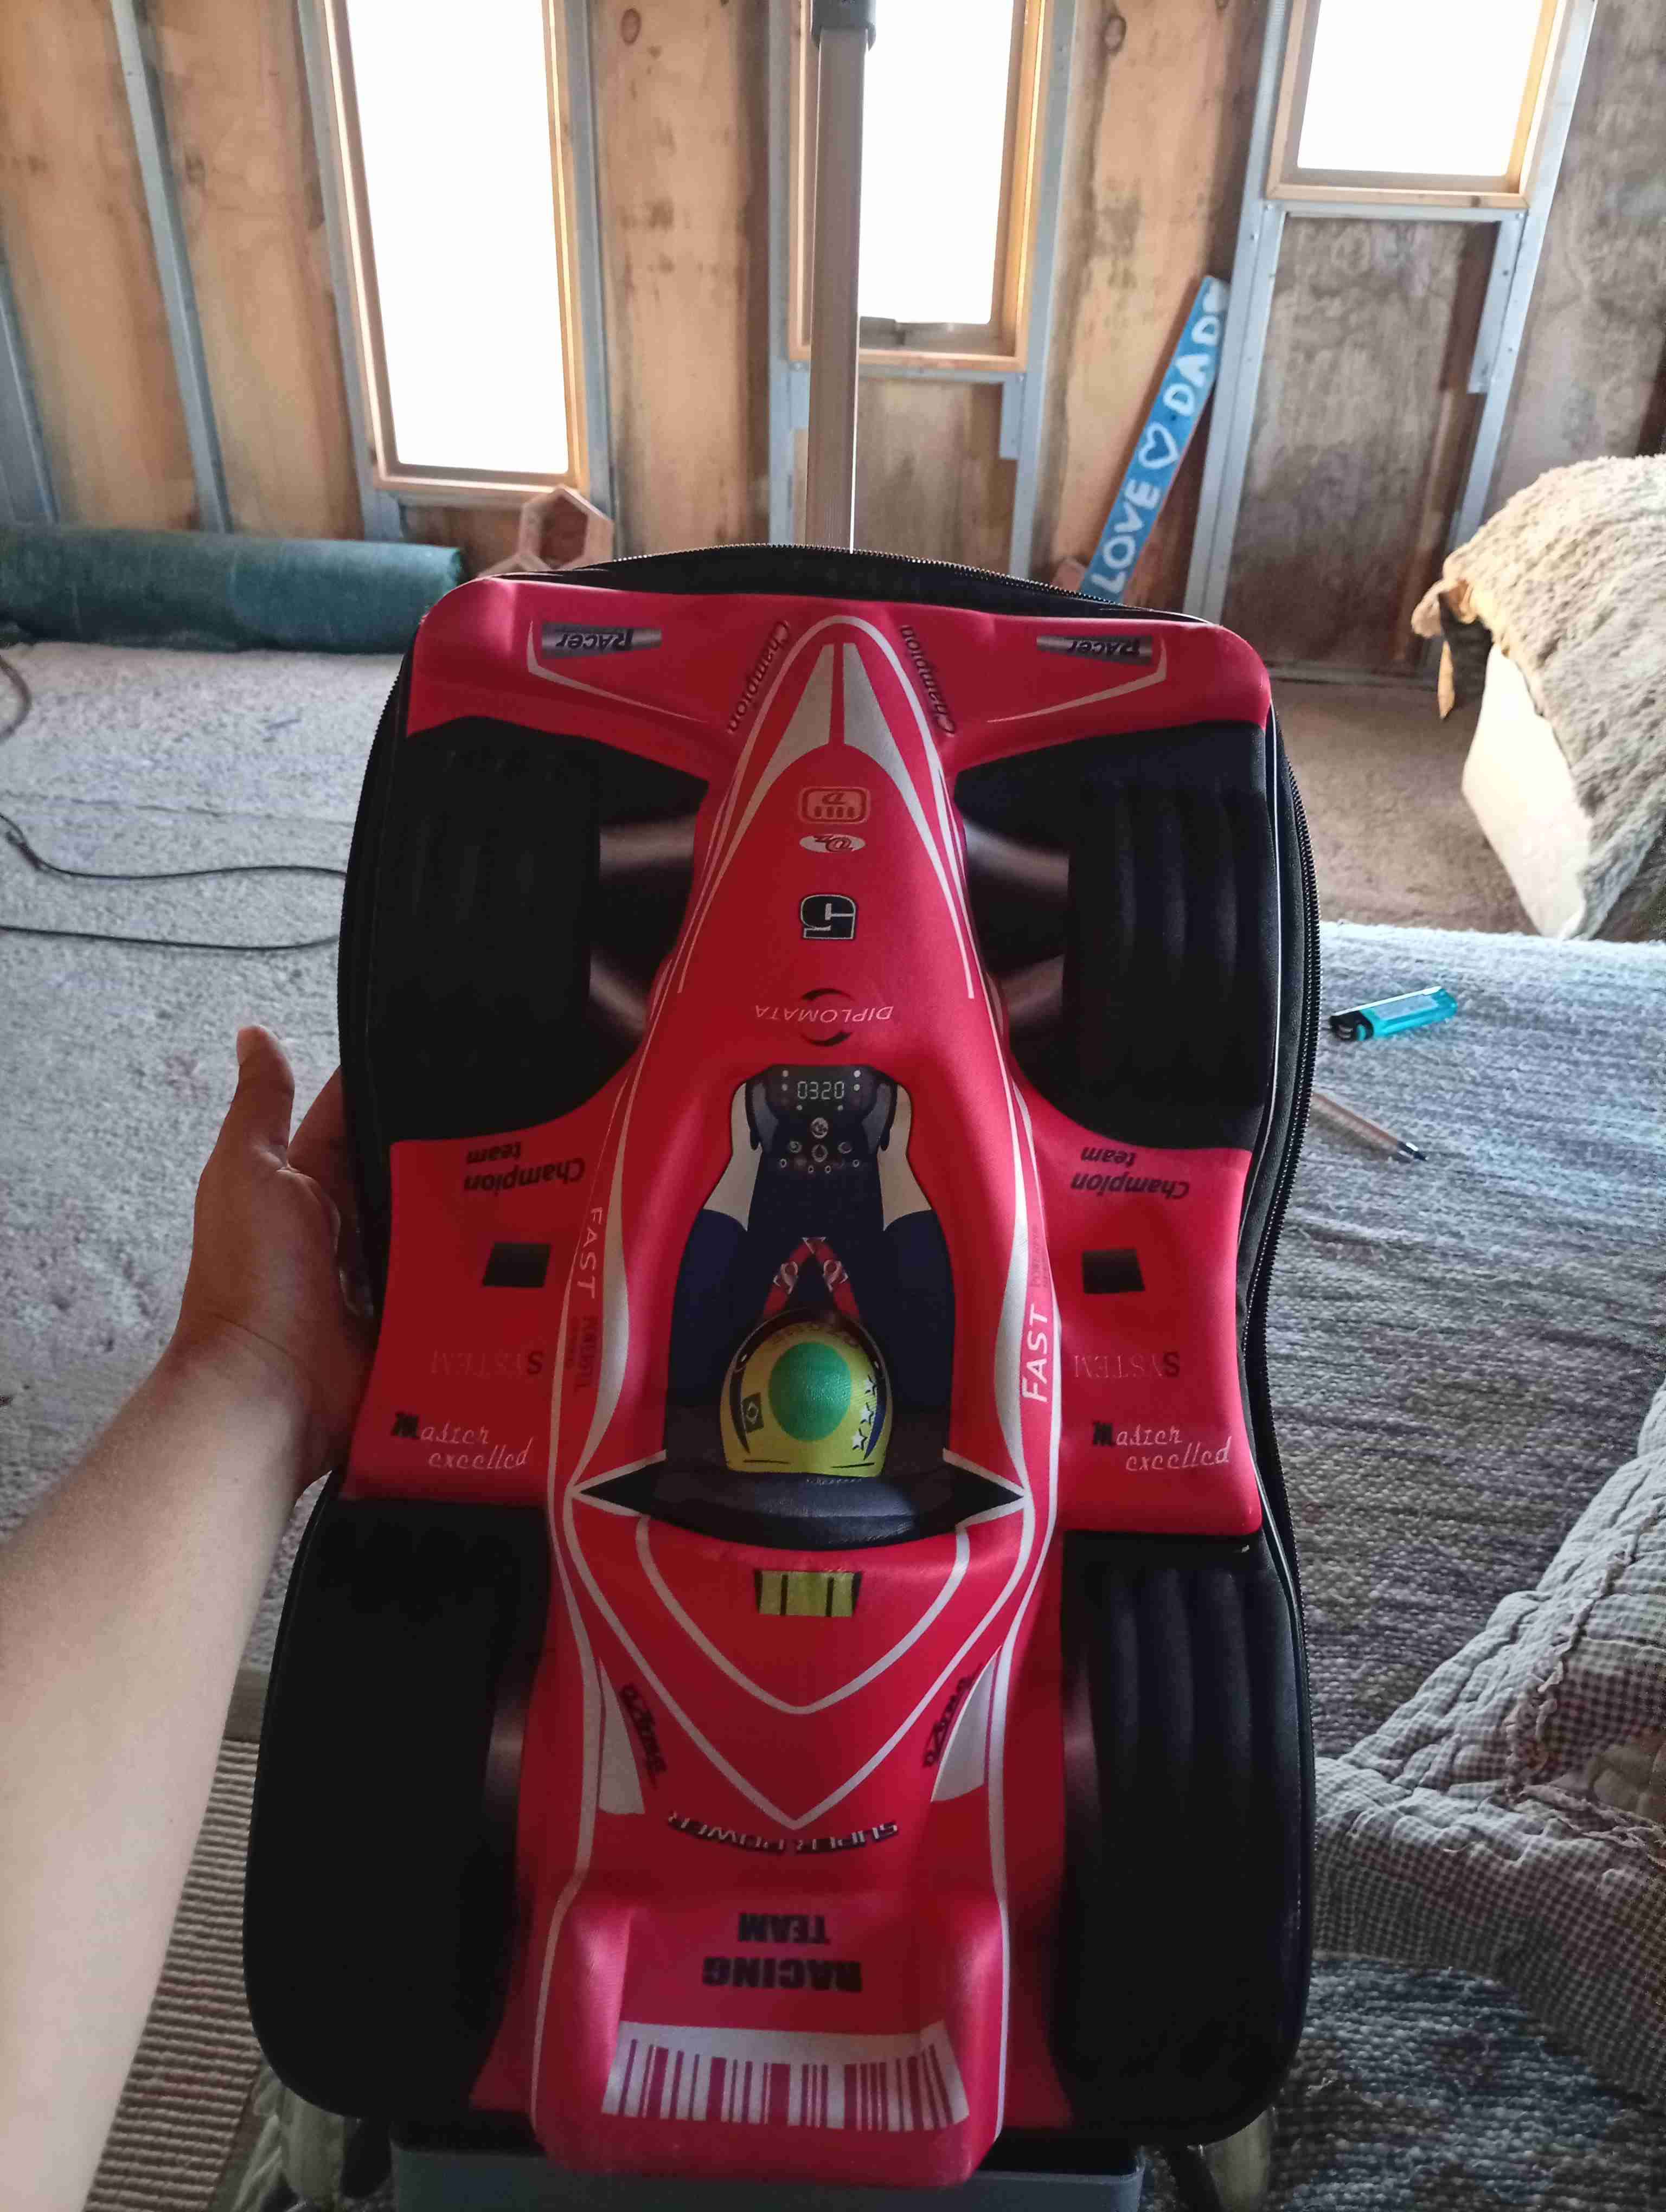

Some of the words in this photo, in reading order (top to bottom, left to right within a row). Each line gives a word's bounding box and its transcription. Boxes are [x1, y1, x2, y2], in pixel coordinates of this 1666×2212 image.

[1091, 478, 1161, 594] LOVE
[901, 625, 954, 737] Champion
[800, 893, 856, 940] 5
[755, 1006, 894, 1023] DIPLOMATA
[797, 1081, 844, 1099] 0320
[466, 1142, 521, 1164] team
[1081, 1147, 1136, 1168] team
[464, 1158, 586, 1197] Champion
[1071, 1172, 1190, 1200] Champion
[577, 1207, 604, 1298] FAST
[1022, 1303, 1048, 1403] FAST
[737, 1913, 830, 1944] TEAM
[702, 1957, 862, 1992] RACING
